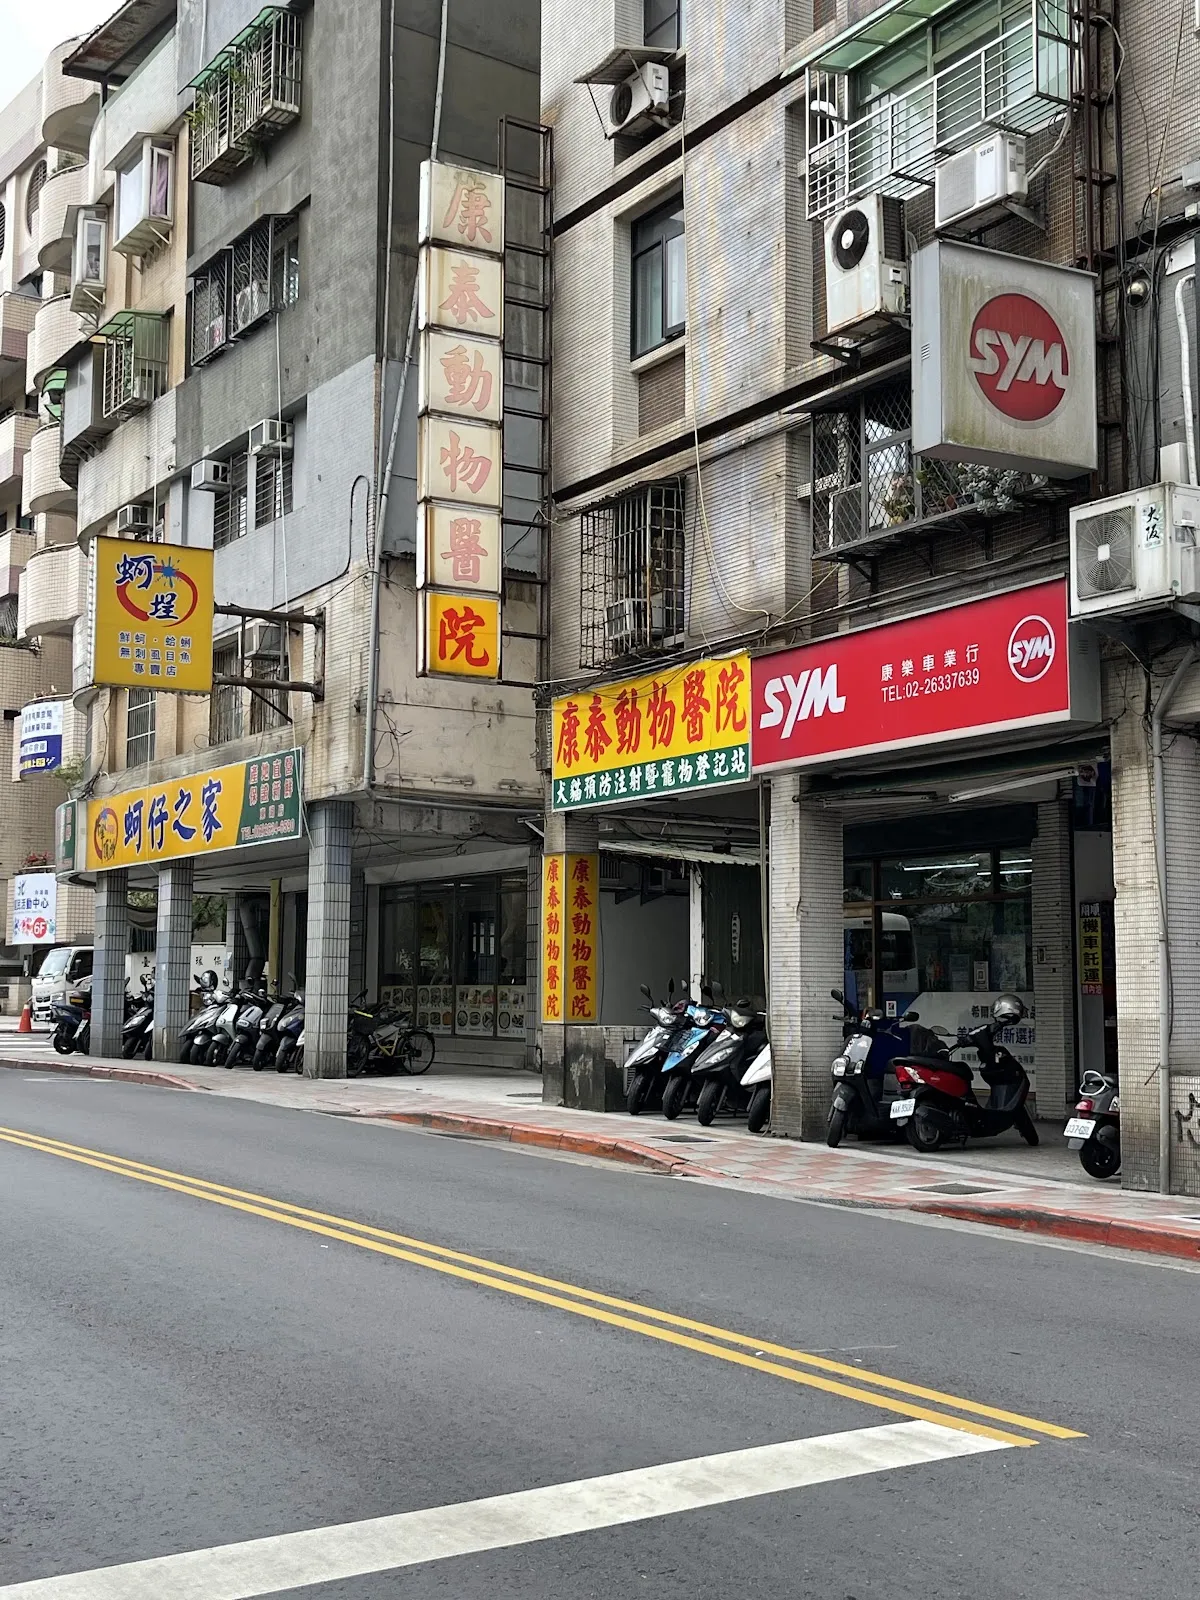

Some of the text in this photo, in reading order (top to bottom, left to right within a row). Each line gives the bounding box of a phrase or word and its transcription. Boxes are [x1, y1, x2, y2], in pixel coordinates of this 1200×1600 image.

[968, 328, 1070, 392] SYM
[438, 174, 497, 667] 康泰動物醫院
[134, 662, 177, 676] 專賣店
[881, 644, 979, 682] 康樂車業行
[1011, 637, 1053, 668] SYM
[557, 661, 747, 769] 康泰動物醫院
[760, 664, 847, 739] SYM
[881, 668, 979, 702] TEL:02-26337639
[556, 747, 746, 804] 犬貓預防注射暨寵物登記站
[124, 778, 222, 854] 蚵仔之家
[33, 921, 46, 935] 6F
[546, 858, 560, 1018] 康泰動物醫院
[571, 858, 593, 1018] 康泰動物醫院
[1082, 919, 1099, 982] 機車託運
